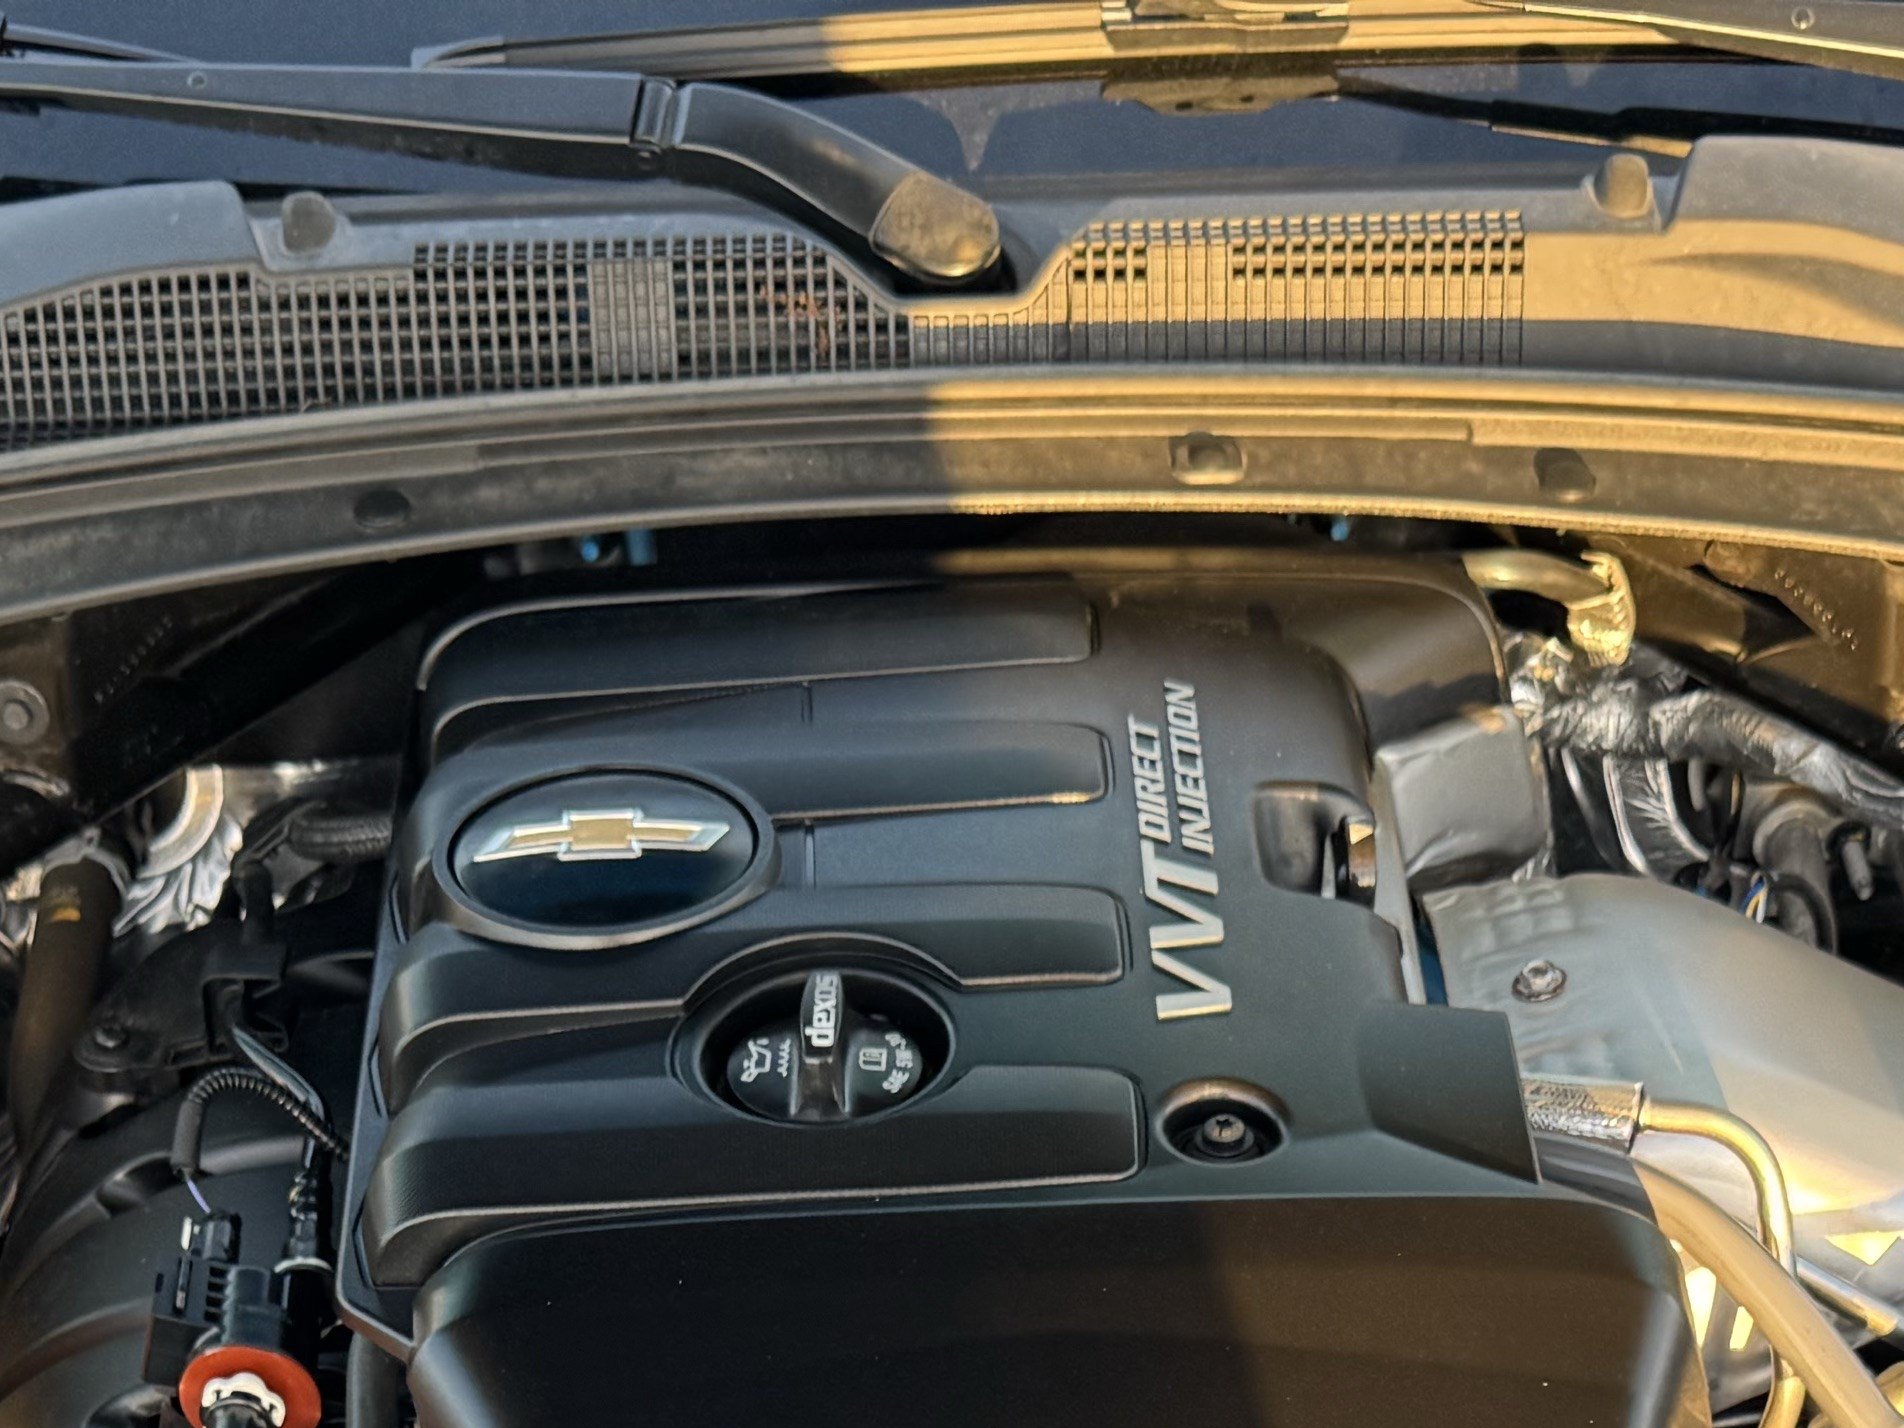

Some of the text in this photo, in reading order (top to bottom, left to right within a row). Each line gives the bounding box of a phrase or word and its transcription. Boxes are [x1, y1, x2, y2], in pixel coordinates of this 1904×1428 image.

[1127, 712, 1173, 844] DIRECT
[1163, 678, 1215, 855] INJECTION
[1140, 839, 1233, 1021] VVT
[804, 974, 838, 1048] dexos
